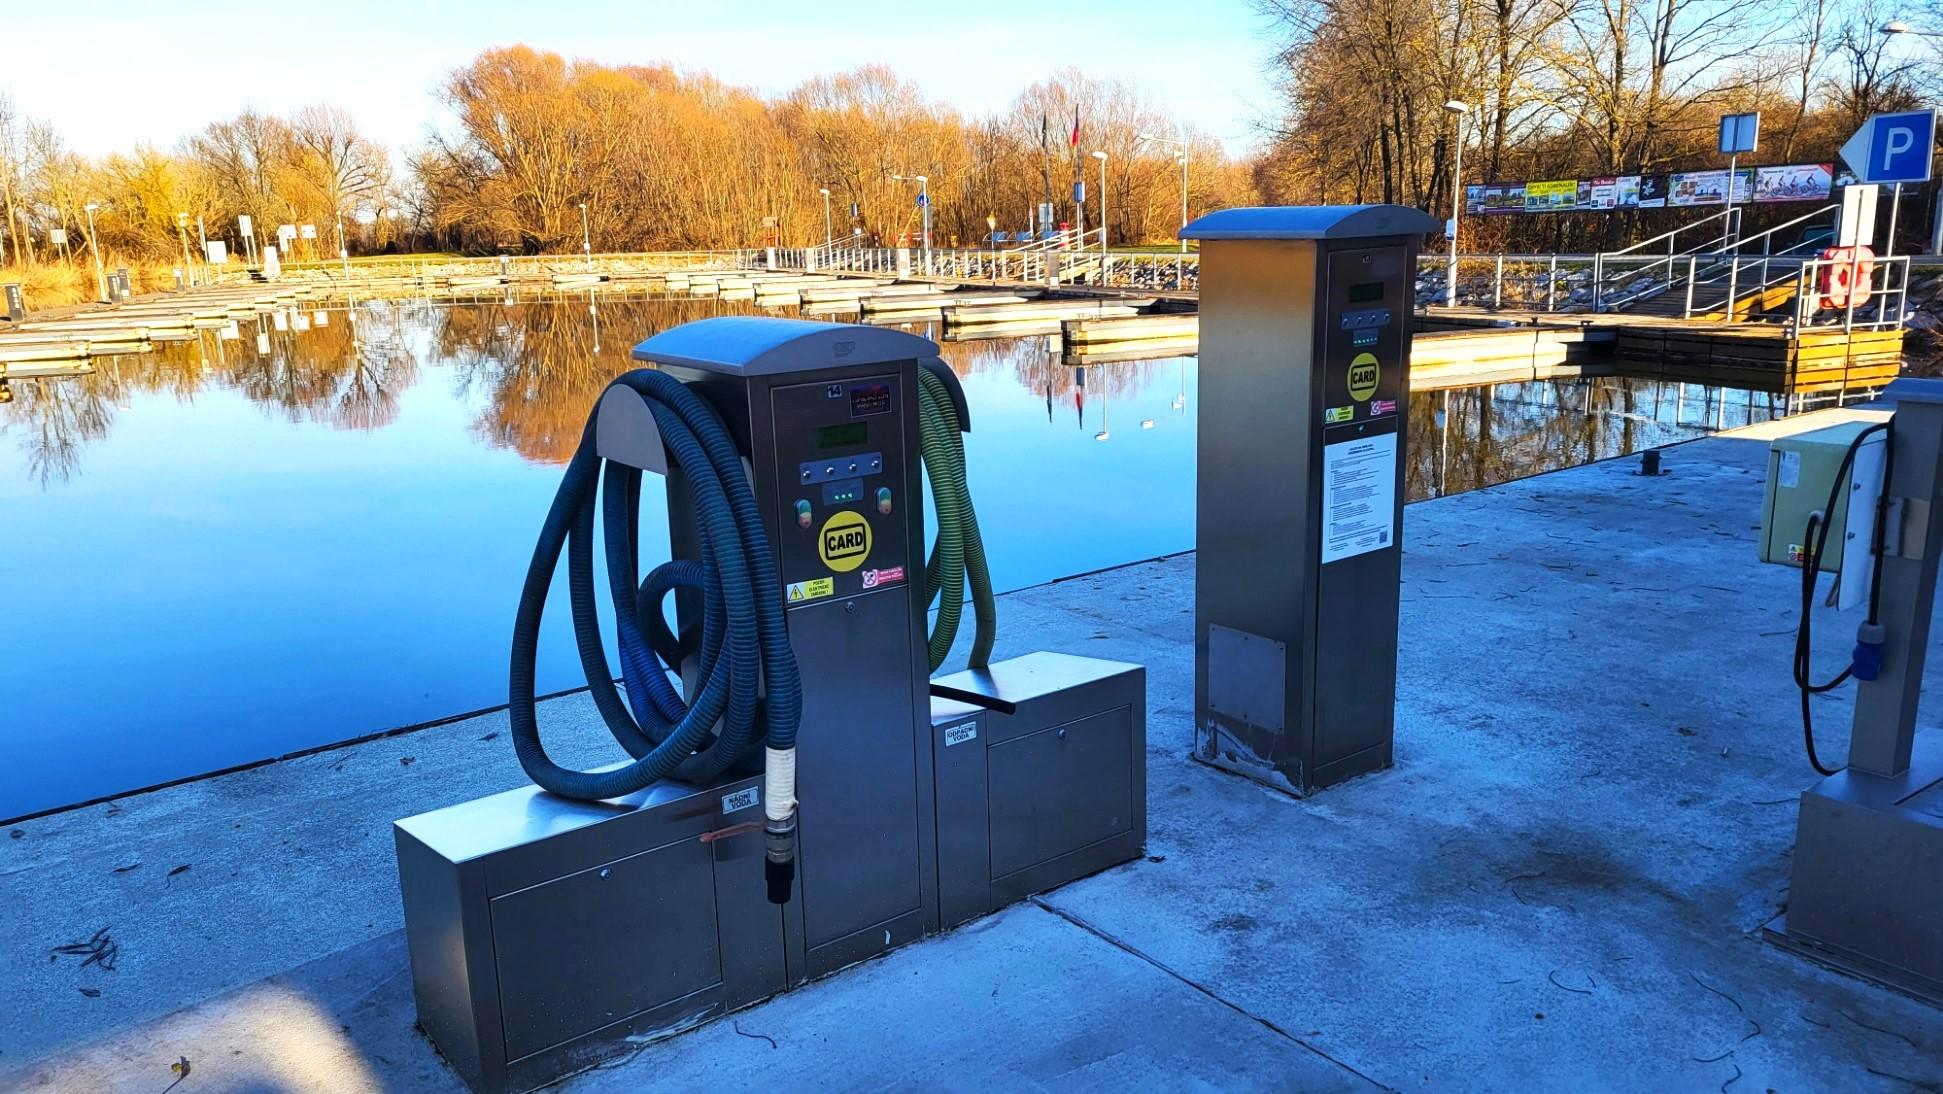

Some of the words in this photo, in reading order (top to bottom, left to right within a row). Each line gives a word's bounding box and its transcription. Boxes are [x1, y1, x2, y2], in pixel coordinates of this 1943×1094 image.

[1883, 127, 1914, 171] P
[1353, 370, 1375, 384] CARD
[829, 385, 841, 397] 14
[828, 532, 863, 551] CARD
[953, 733, 970, 742] VODA
[731, 798, 752, 809] VODA
